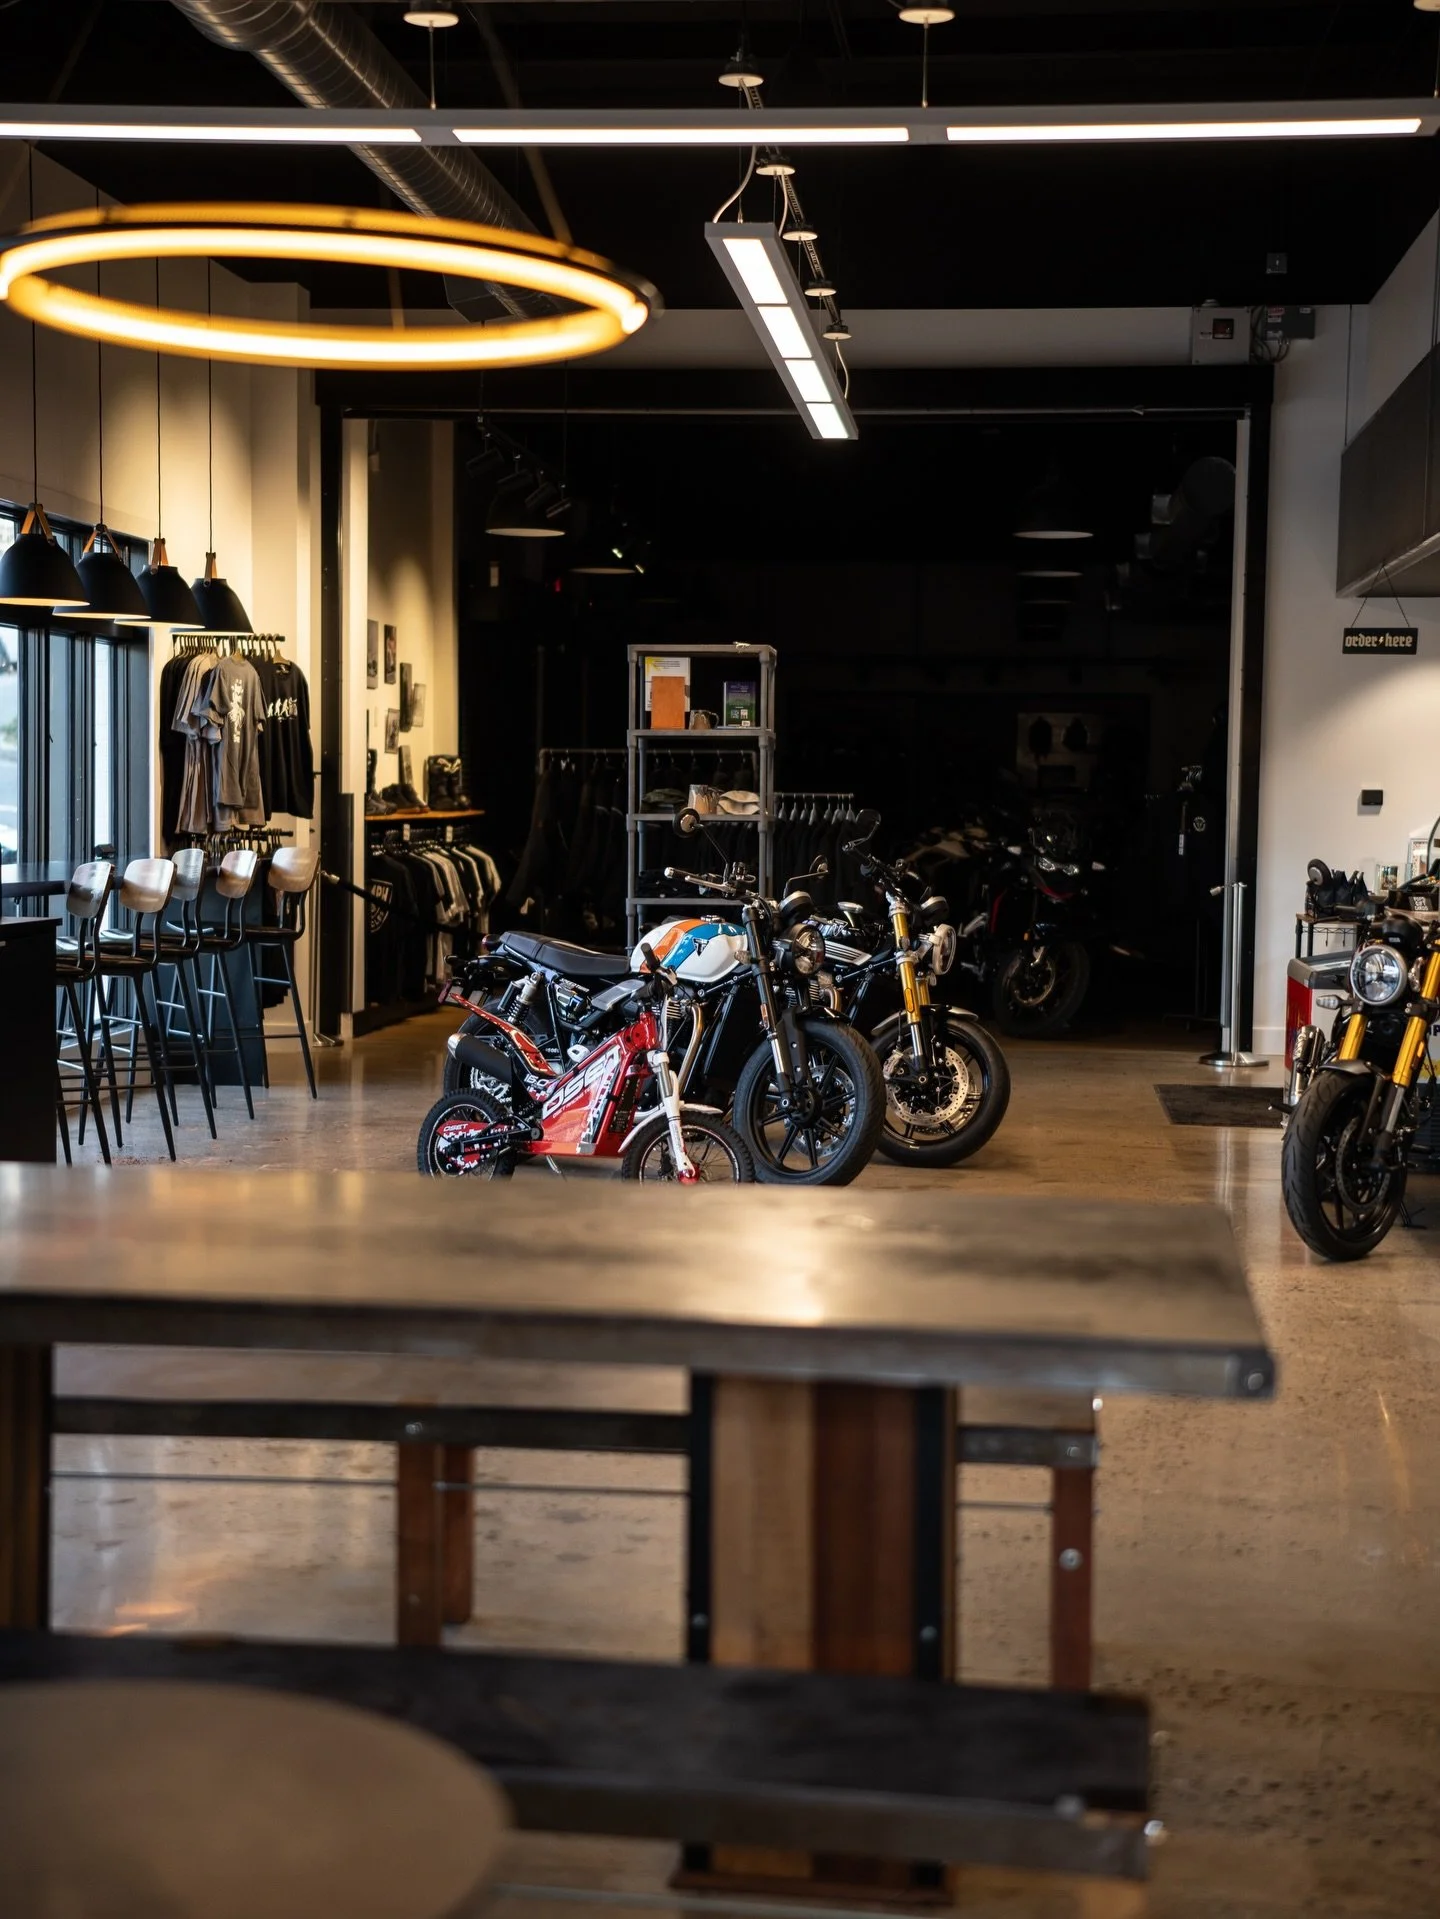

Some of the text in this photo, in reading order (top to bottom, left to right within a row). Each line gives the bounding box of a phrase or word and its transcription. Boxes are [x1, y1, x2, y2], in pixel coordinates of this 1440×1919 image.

[1345, 632, 1413, 648] order here
[542, 1043, 622, 1120] OSET
[443, 1123, 469, 1132] OSET
